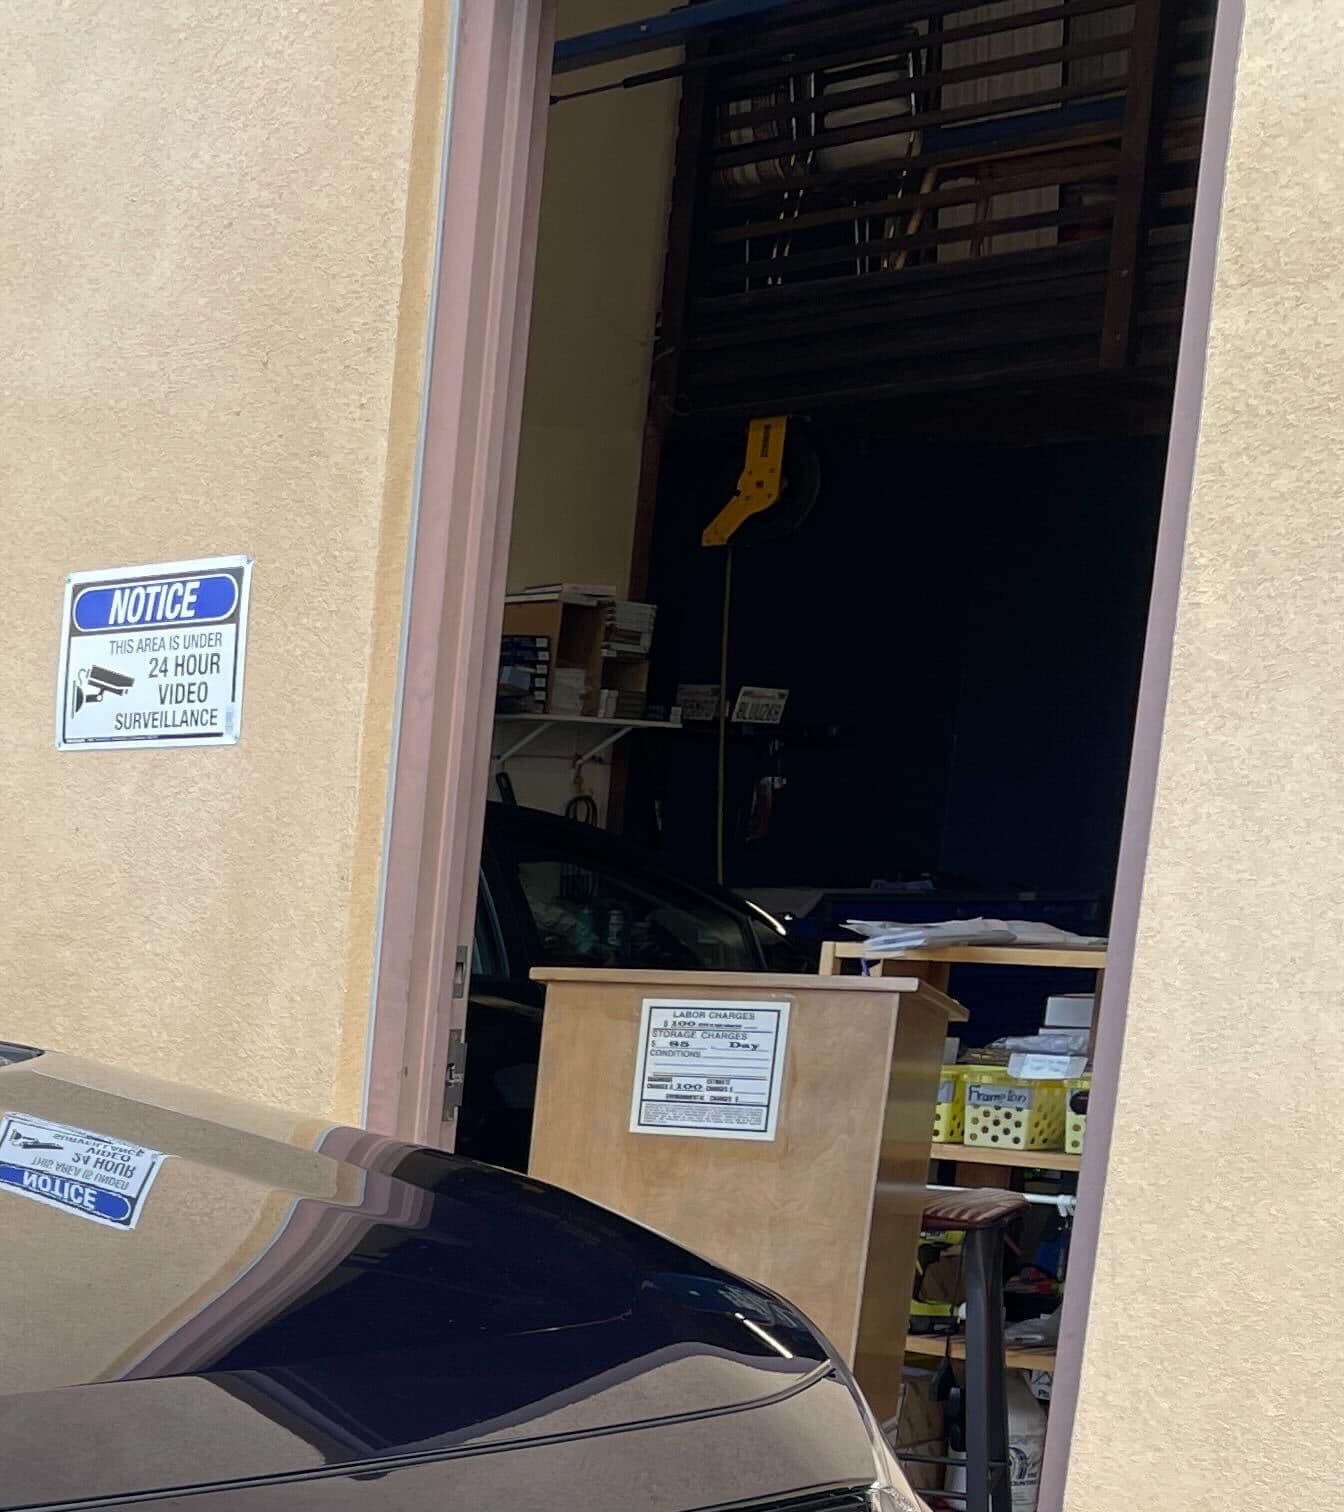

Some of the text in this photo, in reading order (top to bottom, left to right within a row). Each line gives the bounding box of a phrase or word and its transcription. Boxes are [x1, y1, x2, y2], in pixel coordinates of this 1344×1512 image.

[108, 581, 201, 625] NOTICE
[109, 632, 223, 655] THIS AREA IS UNDER
[148, 653, 221, 679] 24 HOUR
[158, 681, 208, 705] VIDEO
[114, 708, 219, 730] SURVEILLANCE
[673, 1010, 756, 1021] LABOR CHARGES
[652, 1030, 748, 1041] STORAGE CHARGES
[729, 1041, 760, 1052] Day
[650, 1049, 702, 1059] CONDITIONS
